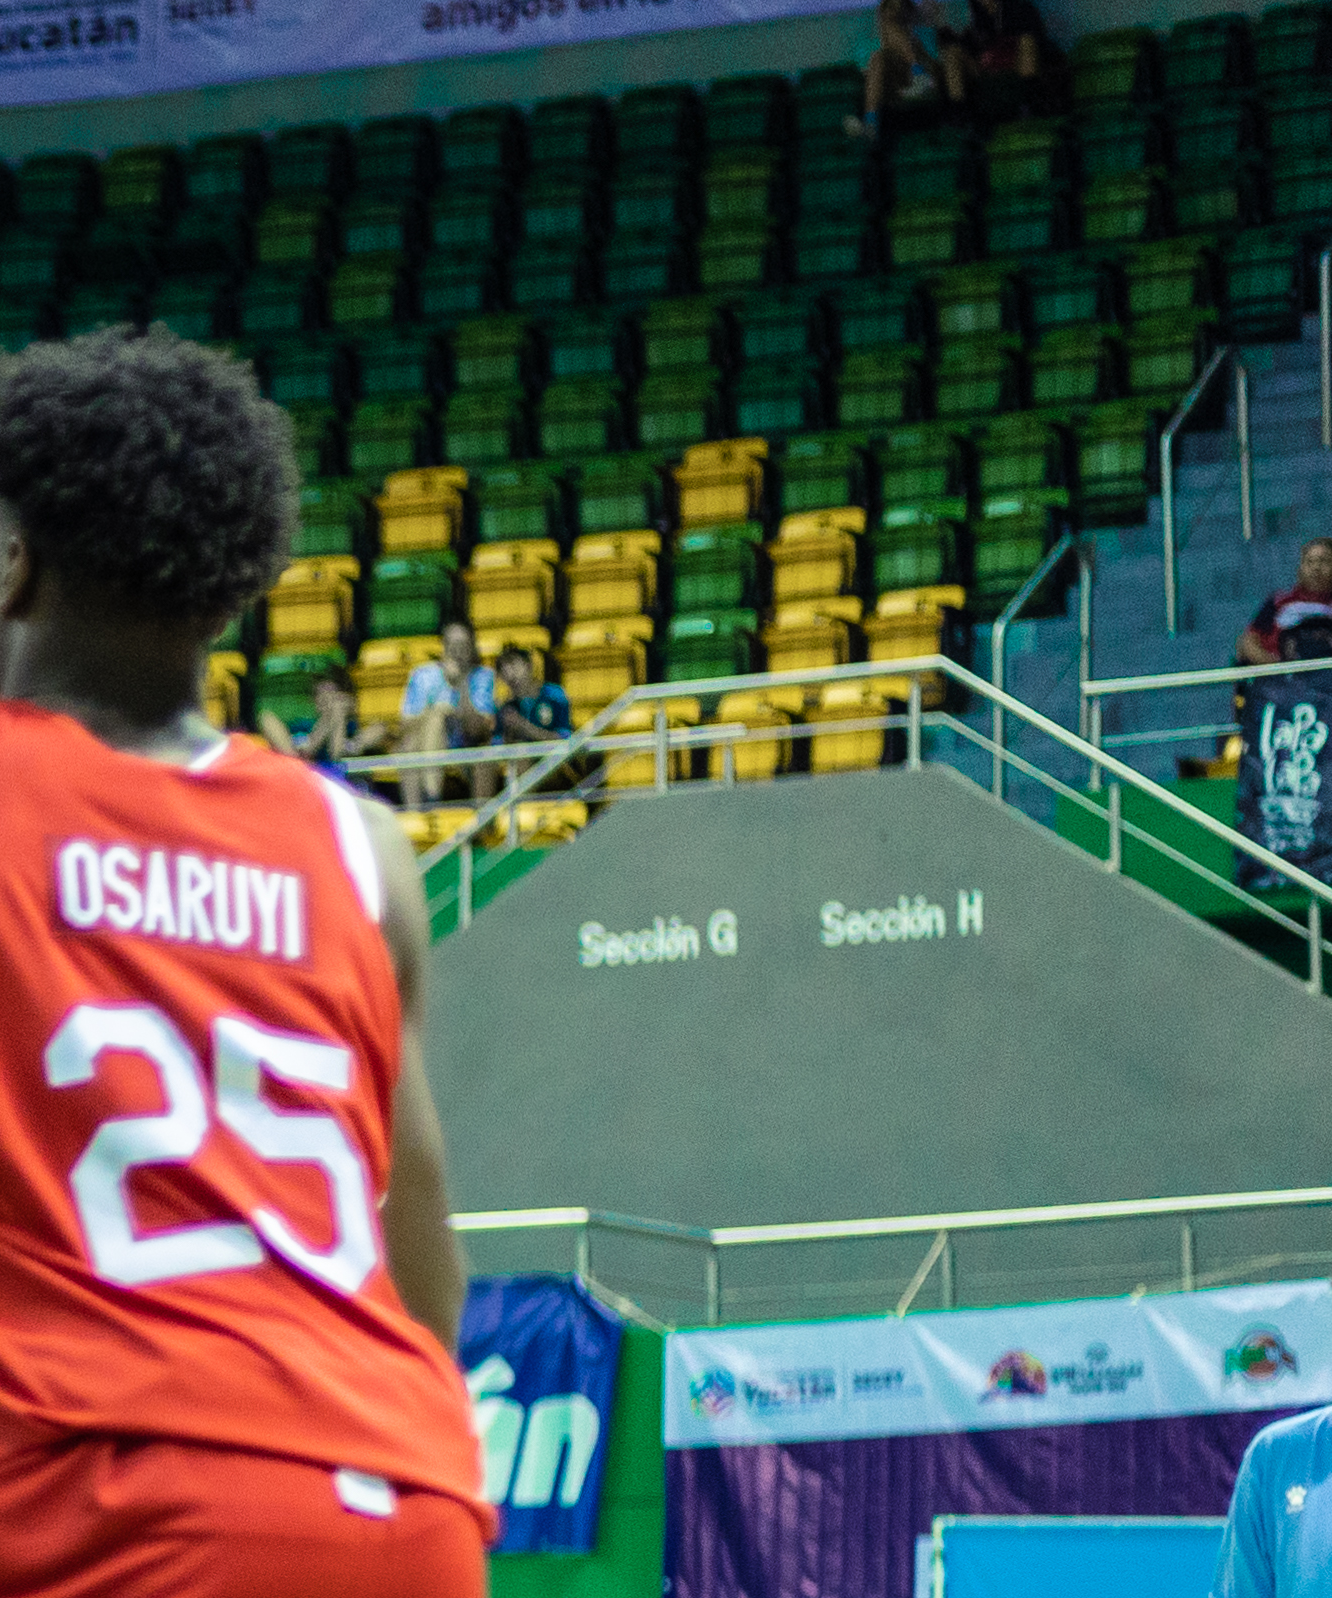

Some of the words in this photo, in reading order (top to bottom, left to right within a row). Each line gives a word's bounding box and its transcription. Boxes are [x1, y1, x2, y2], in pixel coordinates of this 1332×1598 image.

[59, 839, 304, 962] OSARUYI
[706, 907, 738, 957] G
[957, 888, 984, 937] H
[44, 1003, 377, 1293] 25
